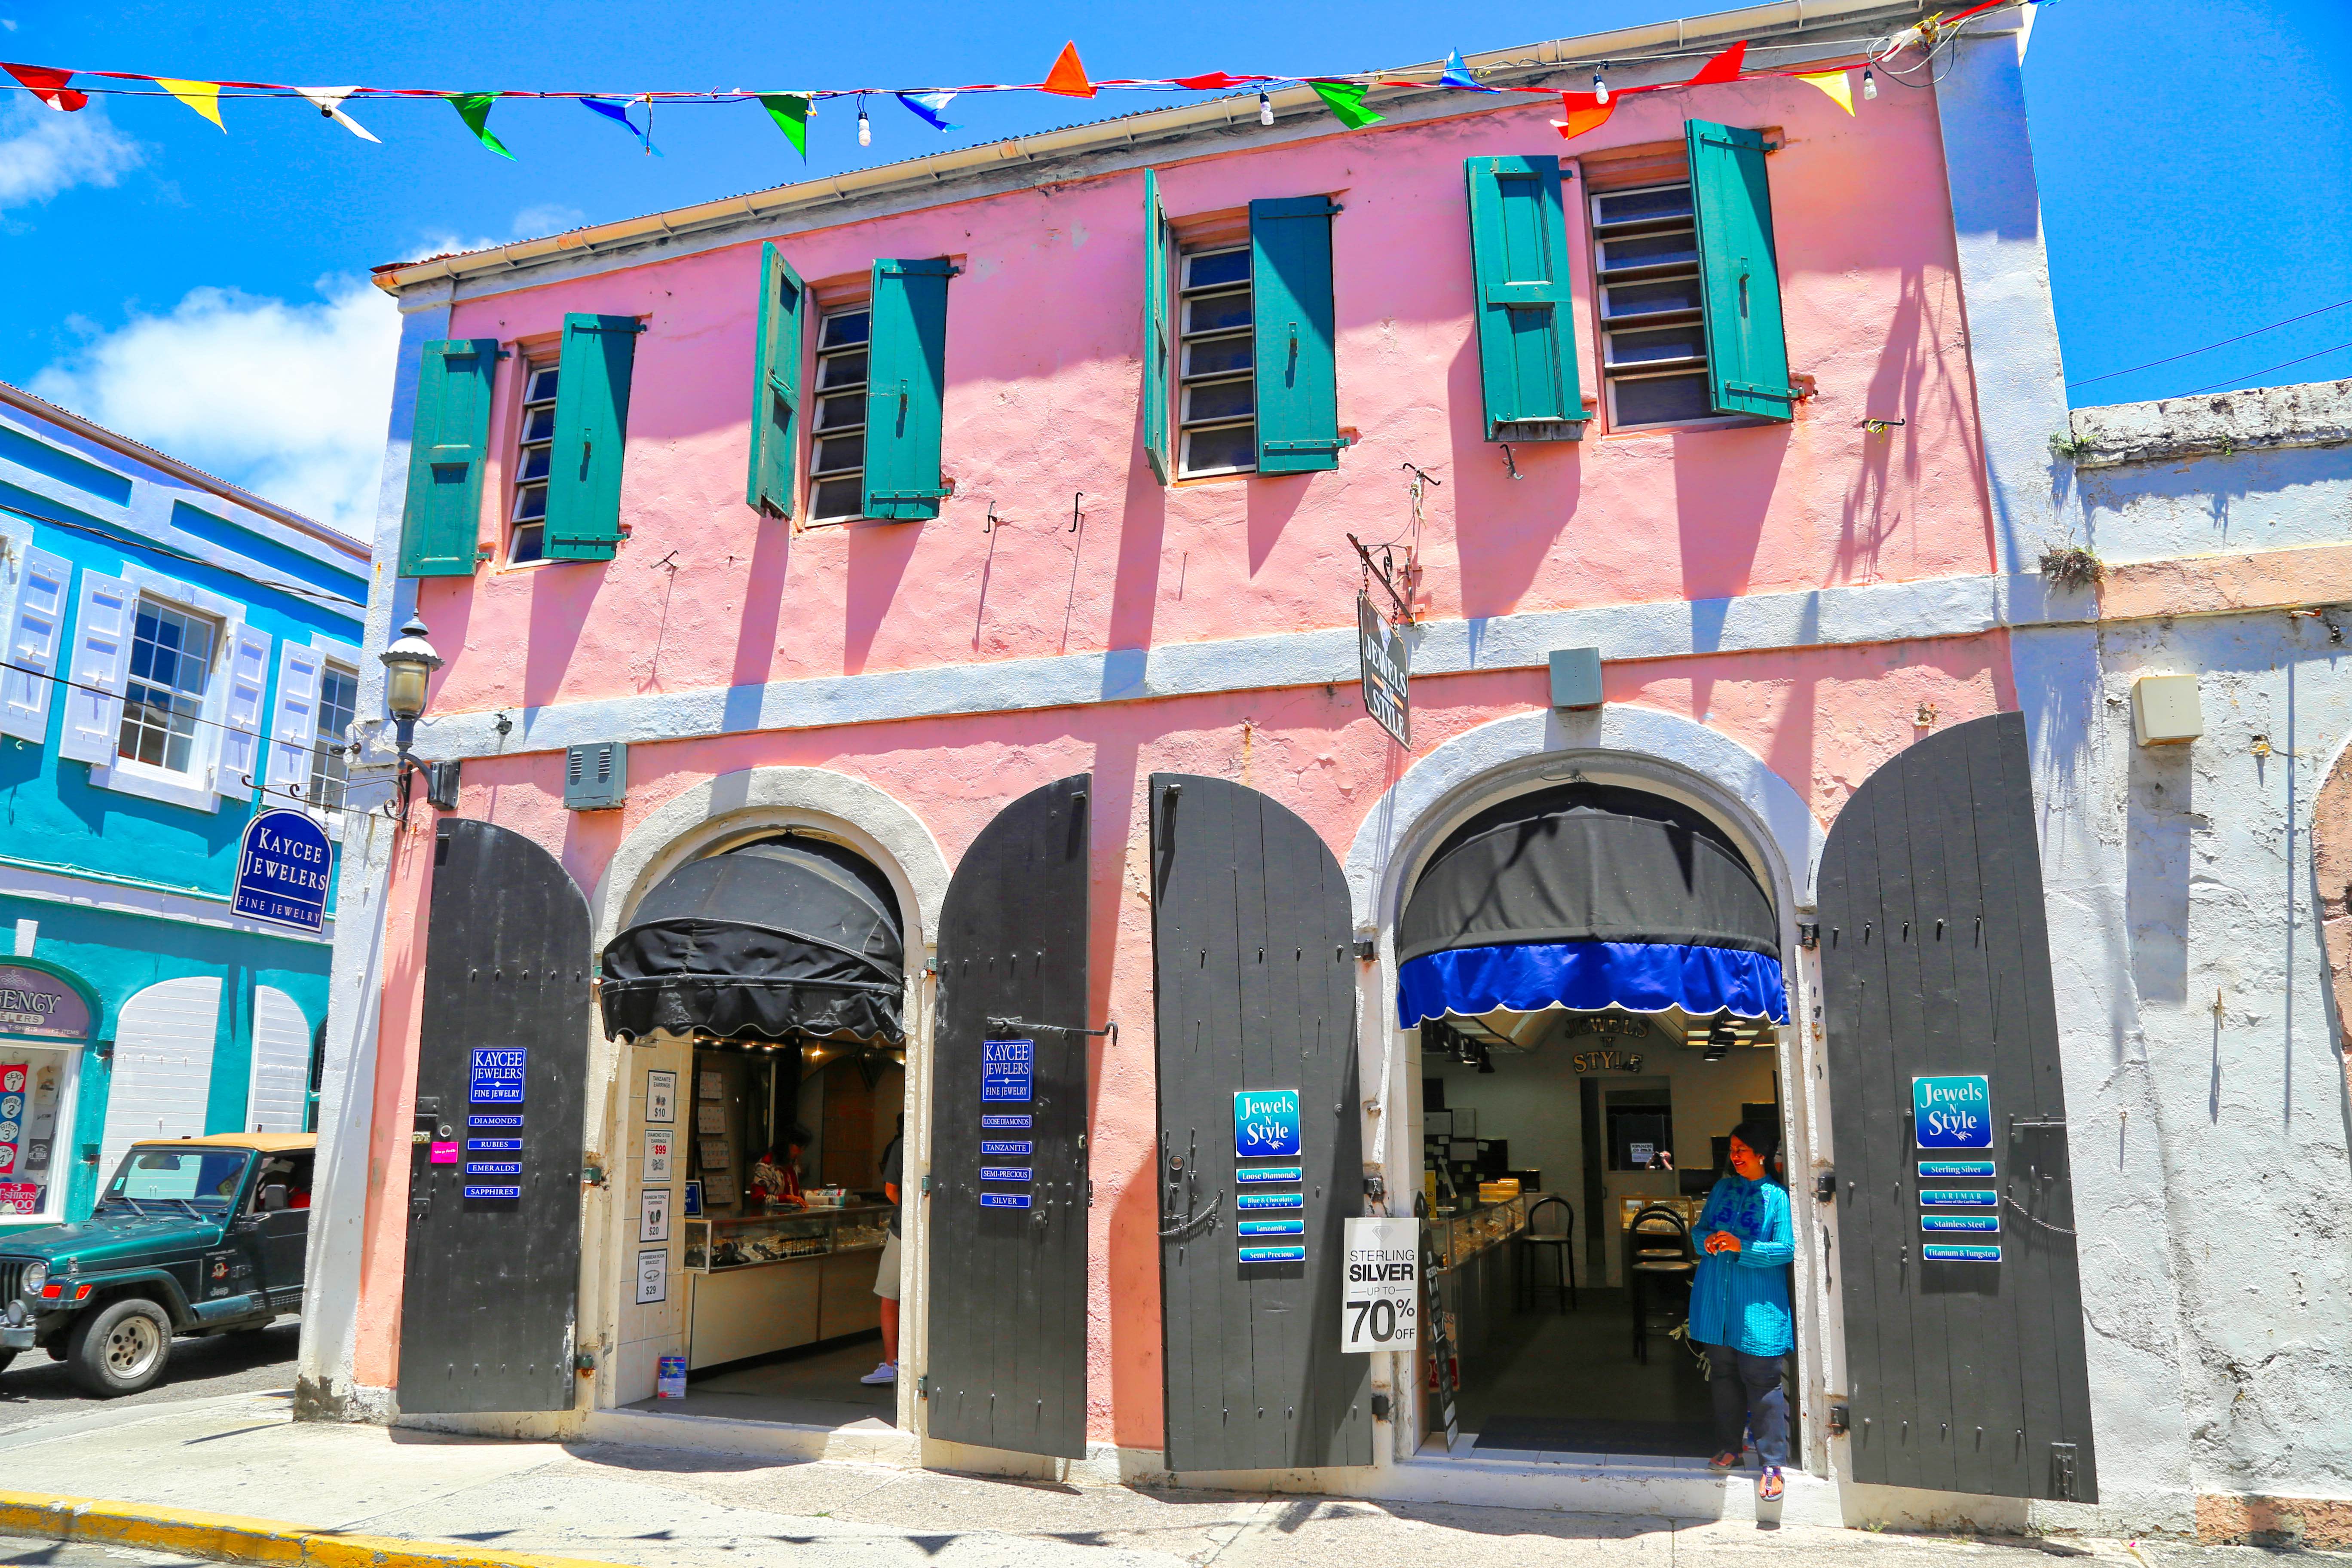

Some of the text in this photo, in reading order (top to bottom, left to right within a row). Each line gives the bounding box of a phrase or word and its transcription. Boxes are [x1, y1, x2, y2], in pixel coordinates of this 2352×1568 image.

[1365, 634, 1407, 698] JEWELS
[1373, 689, 1405, 741] STYLE
[258, 827, 322, 864] KAYCEE
[243, 851, 327, 891] JEWELERS
[238, 895, 320, 923] FINE JEWELRY
[0, 988, 61, 1015] ENCY
[1565, 1014, 1650, 1038] JEWELS
[986, 1044, 1029, 1061] KAYCEE
[475, 1052, 523, 1066] KAYCEE
[1574, 1051, 1643, 1073] STYLE
[6, 1072, 24, 1081] SEXY
[474, 1068, 522, 1082] JEWELERS
[985, 1063, 1029, 1078] JEWELERS
[10, 1080, 16, 1090] 1
[491, 1090, 520, 1099] JEWELRY
[986, 1087, 1027, 1097] FINE JEWELRY
[1920, 1083, 1982, 1108] Jewels
[7, 1105, 15, 1115] 2
[654, 1108, 665, 1118] $10
[1240, 1096, 1294, 1120] Jewels
[1929, 1111, 1977, 1136] Style
[3, 1130, 11, 1140] 3
[1247, 1122, 1289, 1145] Style
[655, 1145, 666, 1155] $99
[983, 1170, 1028, 1178] SEMI-PRECIOUS
[1263, 1171, 1296, 1179] Diamonds
[1931, 1165, 1960, 1174] Sterling
[10, 1183, 21, 1191] 3
[649, 1226, 659, 1236] $20
[1250, 1251, 1295, 1259] Semi-Precious
[1350, 1249, 1414, 1262] STERLING
[1928, 1249, 1959, 1257] Titanium
[1966, 1250, 1996, 1259] Tungsten
[1349, 1263, 1414, 1282] SILVER
[210, 1287, 228, 1296] Jeep
[646, 1286, 656, 1296] $29
[1367, 1286, 1395, 1296] UP TO
[1346, 1298, 1415, 1343] 70%
[1395, 1328, 1415, 1340] OFF
